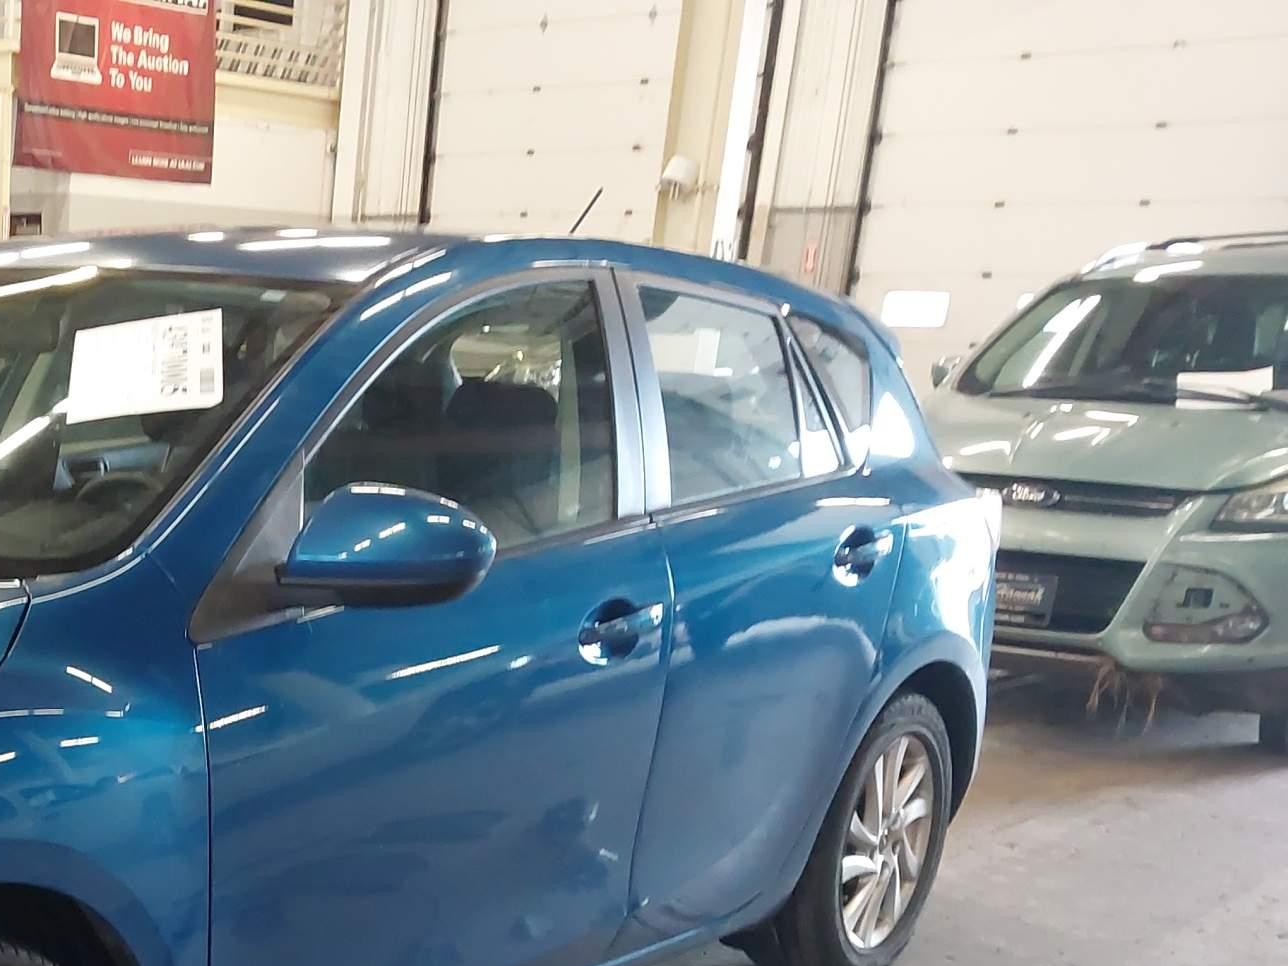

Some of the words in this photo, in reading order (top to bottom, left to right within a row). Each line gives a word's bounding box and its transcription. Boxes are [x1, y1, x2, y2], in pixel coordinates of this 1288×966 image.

[111, 20, 132, 44] We
[133, 25, 170, 54] Bring
[110, 45, 135, 67] The
[137, 49, 189, 76] Auction
[109, 67, 126, 89] To
[129, 70, 153, 93] You
